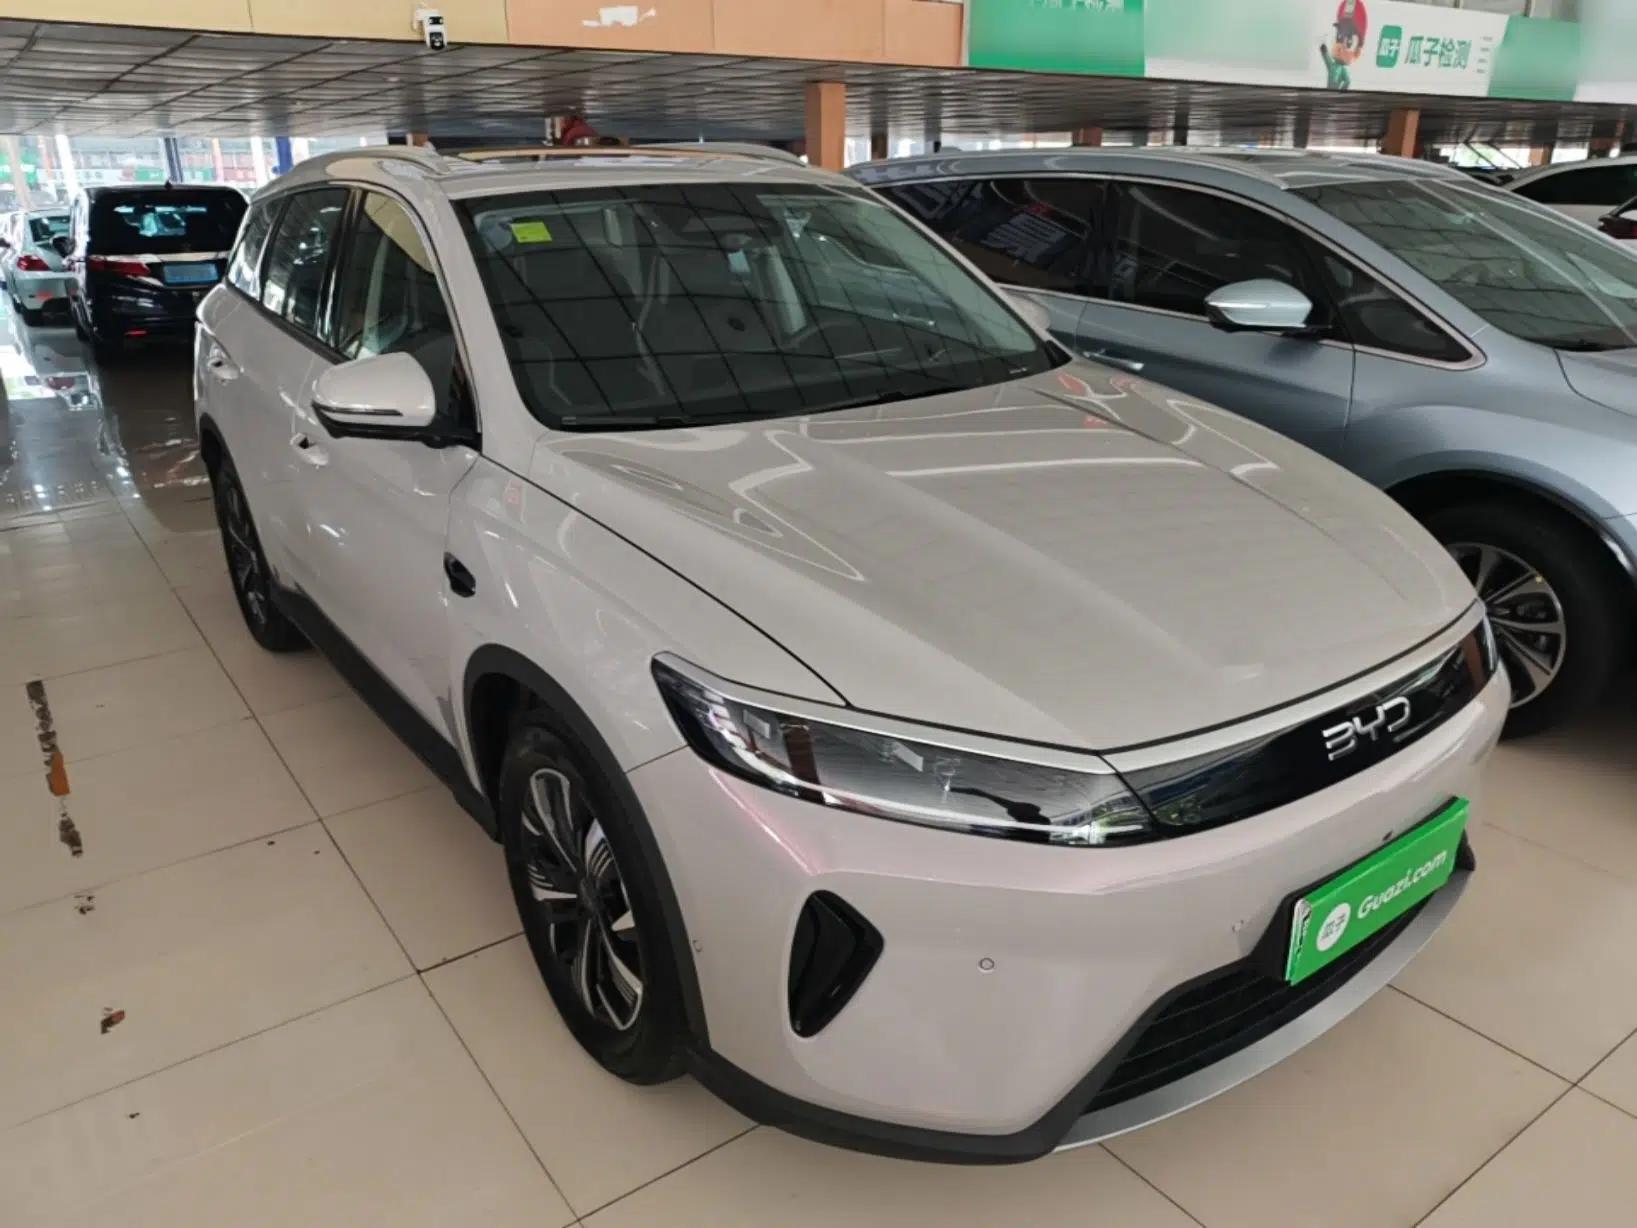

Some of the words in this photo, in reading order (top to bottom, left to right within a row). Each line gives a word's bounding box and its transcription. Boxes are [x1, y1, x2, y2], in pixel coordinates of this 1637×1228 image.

[1404, 36, 1472, 69] 瓜子检测
[1322, 697, 1411, 761] BYD
[1357, 851, 1448, 919] Guazi.com
